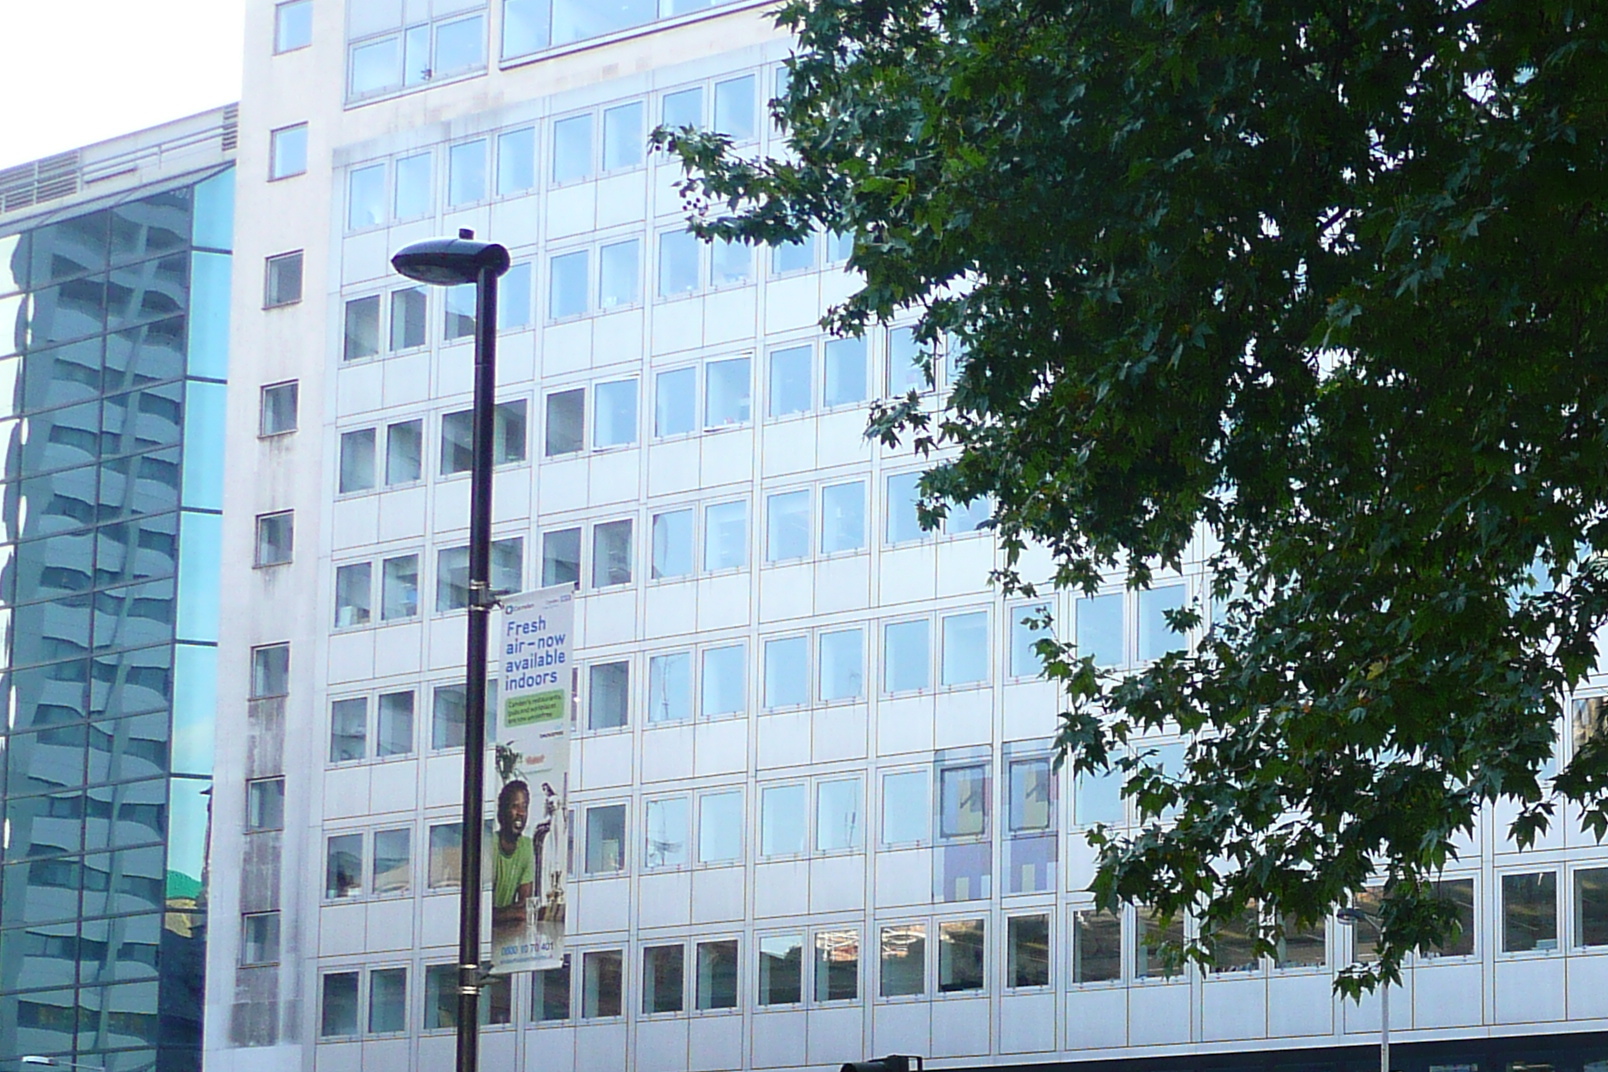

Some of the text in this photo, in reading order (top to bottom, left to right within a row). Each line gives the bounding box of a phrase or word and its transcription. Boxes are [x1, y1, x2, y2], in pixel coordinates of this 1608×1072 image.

[507, 615, 546, 636] Fresh
[506, 649, 565, 673] available
[505, 671, 557, 691] indoors
